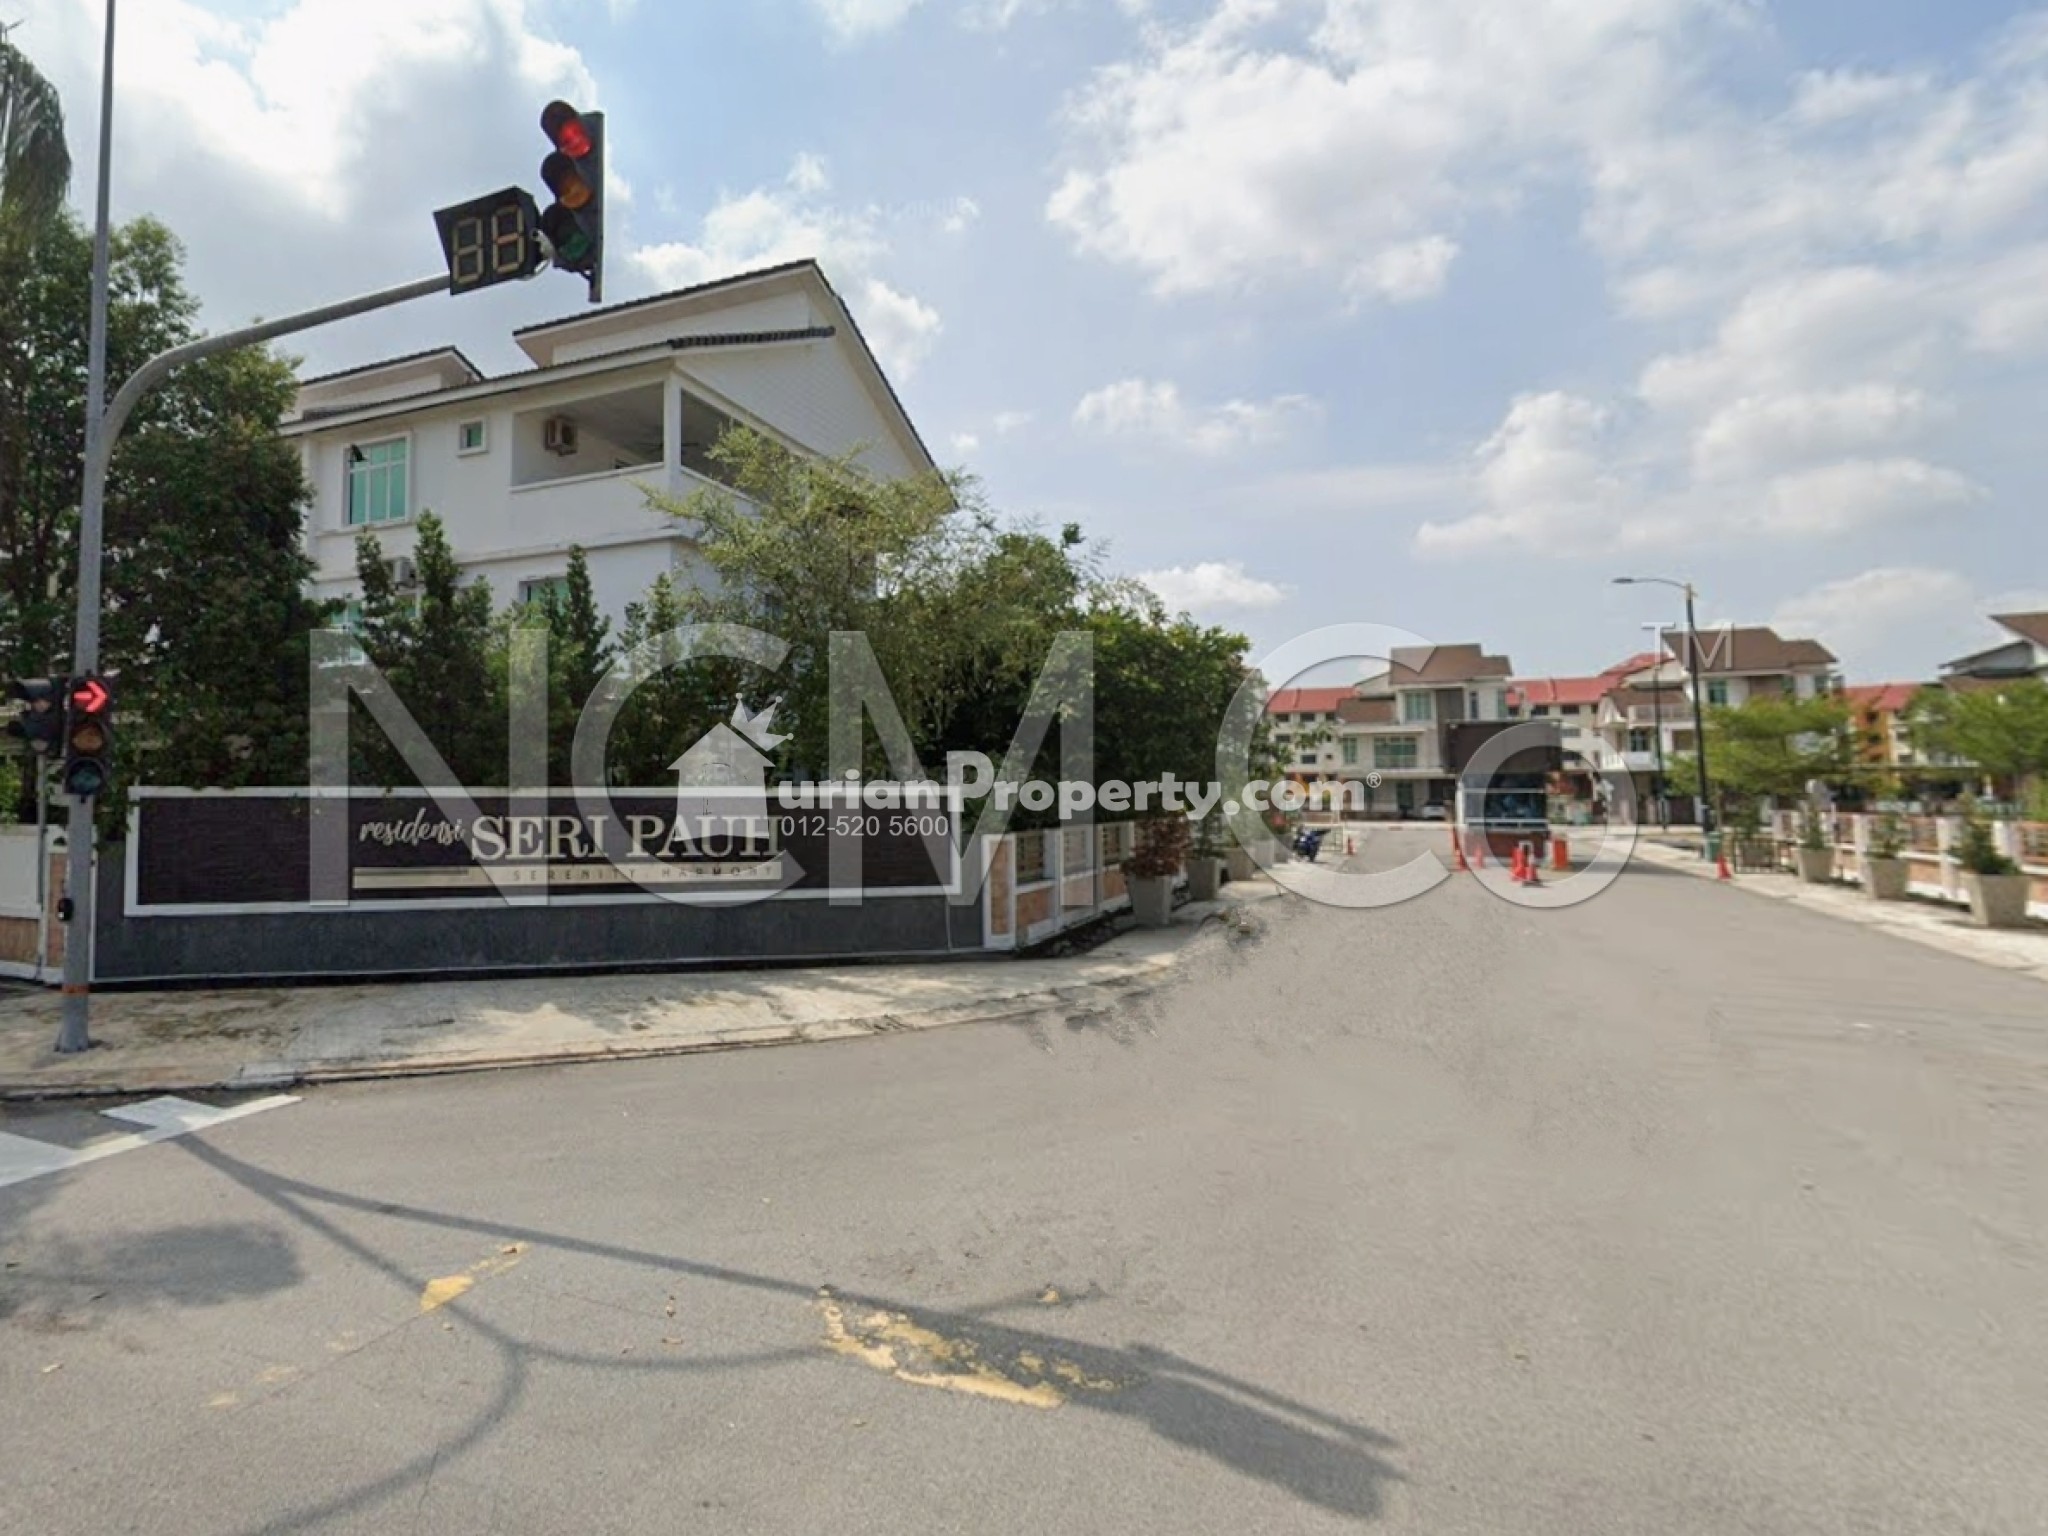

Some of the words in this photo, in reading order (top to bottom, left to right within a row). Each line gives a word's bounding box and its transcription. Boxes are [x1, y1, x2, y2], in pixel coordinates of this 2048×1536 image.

[359, 807, 466, 846] residensi
[471, 814, 610, 861] SERI
[625, 814, 783, 858] PAUH
